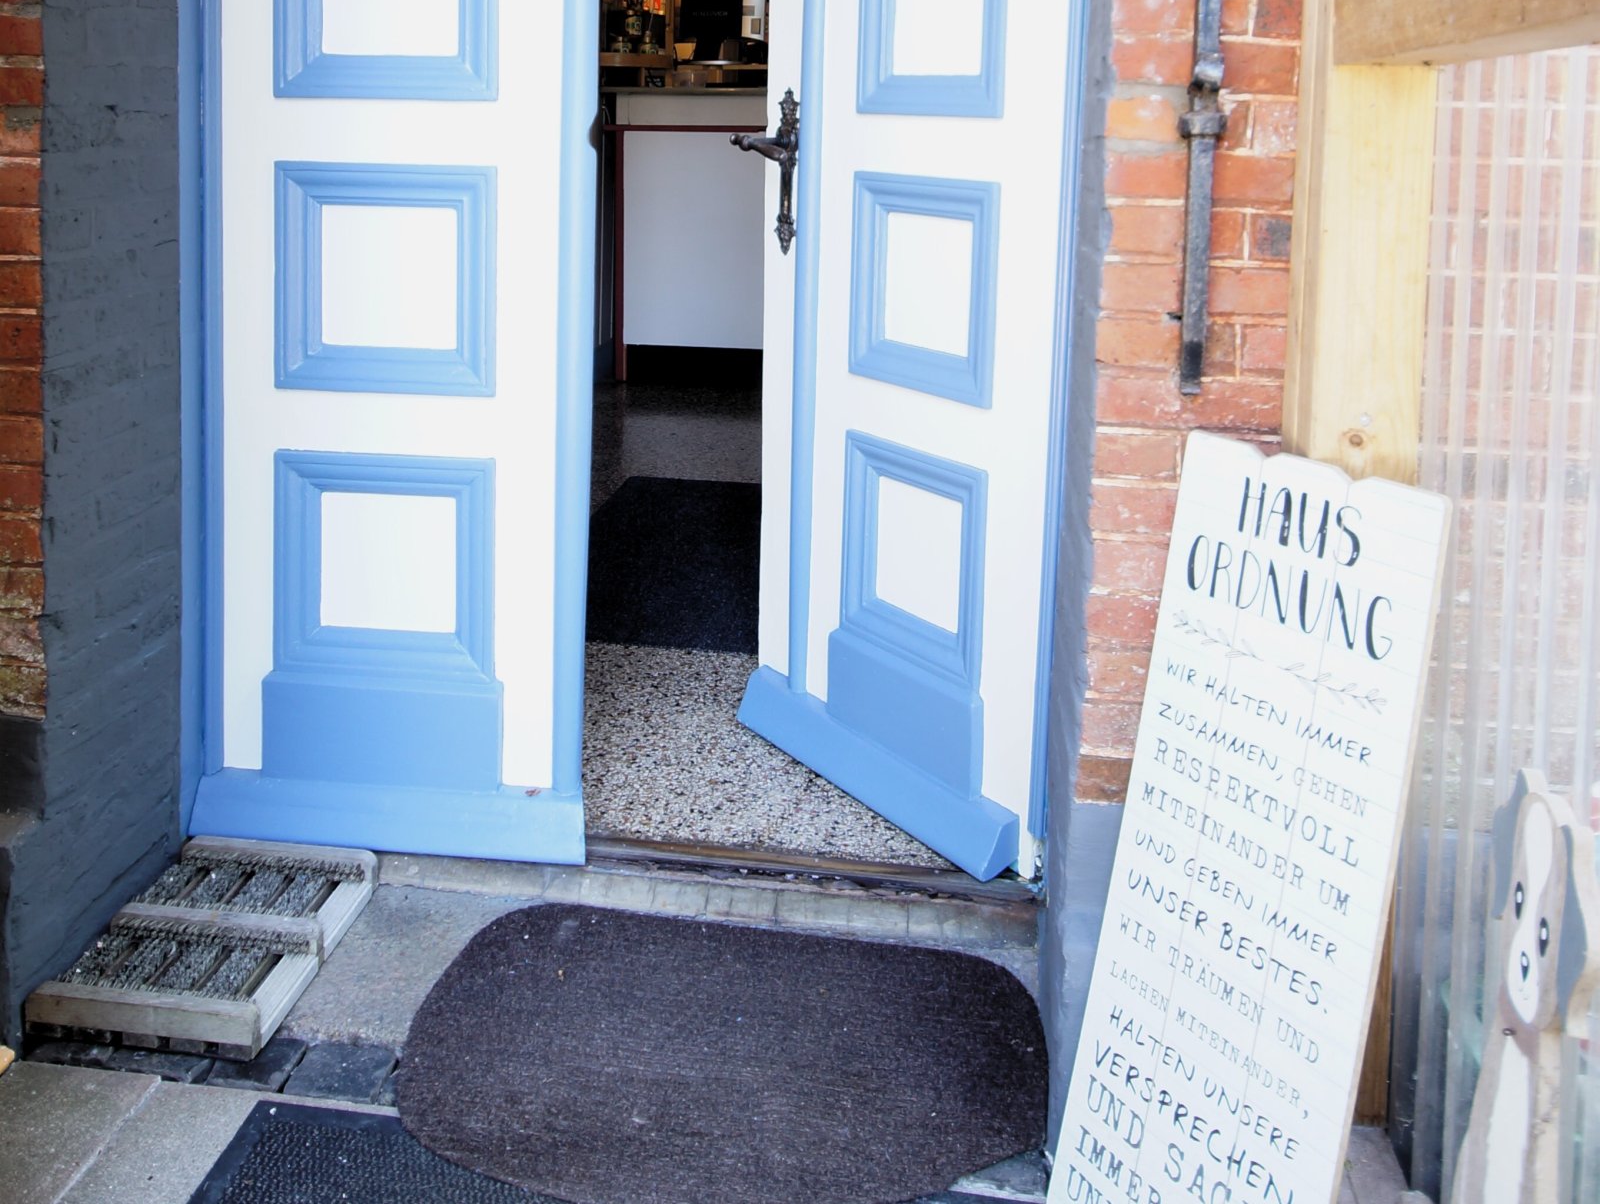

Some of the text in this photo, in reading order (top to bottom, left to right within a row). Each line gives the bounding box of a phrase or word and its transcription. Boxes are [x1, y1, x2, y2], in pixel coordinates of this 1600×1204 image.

[1238, 477, 1362, 567] HAUS
[1187, 535, 1393, 660] ORDNUNG
[1158, 702, 1369, 818] ZUSAMMEN, GEHEN
[1166, 657, 1372, 767] WIR HALTEN IMMER
[1141, 781, 1351, 917] MITEINANDER UM
[1154, 737, 1360, 868] RESPEKTVOLL
[1127, 868, 1328, 1015] UNSER BESTES.
[1135, 829, 1338, 965] UND GEBEN IMMER
[1109, 960, 1309, 1120] LACHEN MITEINANDER,
[1119, 913, 1321, 1064] WIR TRÄUMEN UND
[1086, 1074, 1145, 1150] UND
[1094, 1039, 1294, 1204] VERSPRECHEN
[1110, 1005, 1300, 1160] HALTEN UNSERE
[1066, 1163, 1112, 1204] UN
